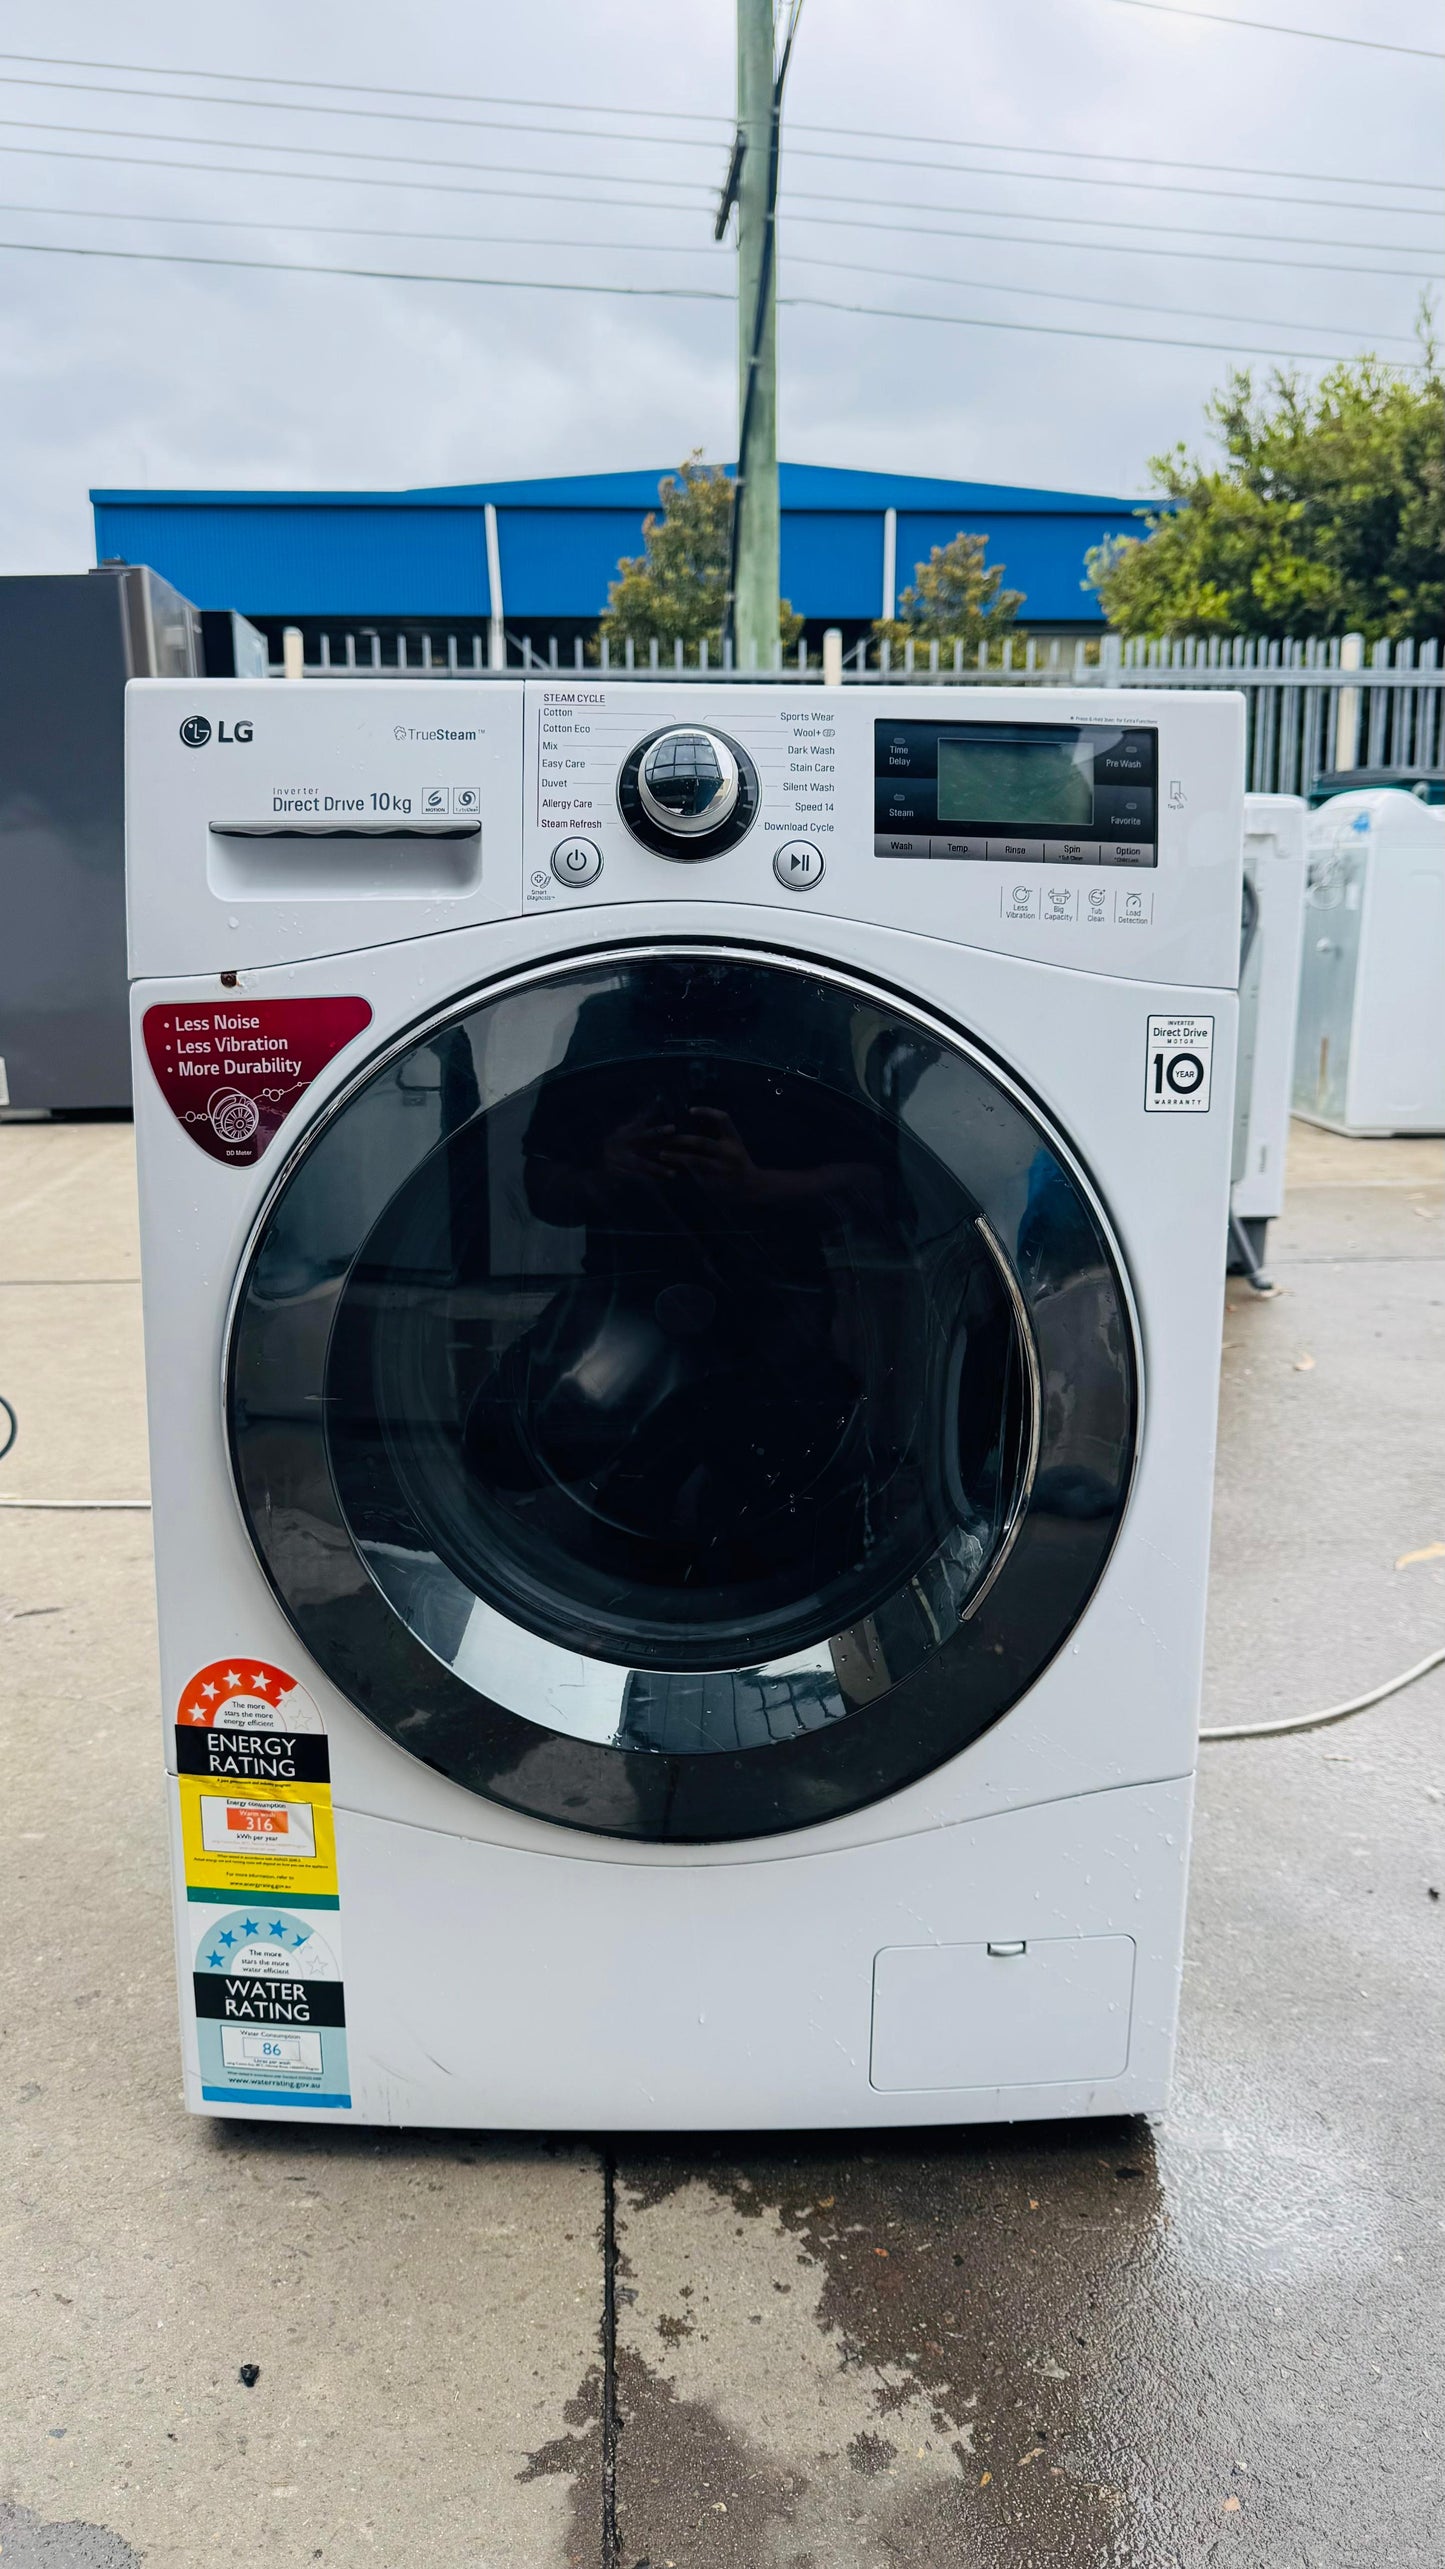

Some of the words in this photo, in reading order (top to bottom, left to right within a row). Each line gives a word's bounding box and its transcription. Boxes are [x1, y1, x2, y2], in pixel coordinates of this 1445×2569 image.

[543, 693, 575, 703] STEAM
[577, 694, 606, 703] CYCLE
[543, 707, 573, 717] Cotton
[780, 712, 810, 722] Sports
[811, 712, 835, 721] Wear
[218, 720, 254, 743] LG
[542, 723, 573, 733] Cotton
[574, 724, 591, 733] Eco
[793, 728, 822, 737] Wool+
[542, 741, 558, 750] Mix
[787, 745, 808, 755] Dark
[810, 746, 835, 755] Wash
[890, 745, 908, 755] Time
[542, 759, 563, 769] Easy
[565, 759, 586, 768] Care
[889, 756, 911, 767] Delay
[1106, 758, 1119, 768] Pre
[1120, 760, 1142, 769] Wash
[790, 762, 813, 772] Stain
[814, 763, 835, 772] Care
[541, 778, 568, 788] Duvet
[782, 782, 808, 791] Silent
[810, 783, 835, 792] Wash
[272, 787, 320, 795] Inverter
[273, 796, 320, 812] Direct
[324, 796, 365, 812] Drive
[370, 792, 390, 811] 10
[393, 795, 412, 814] kg
[542, 798, 572, 809] Allergy
[573, 799, 593, 808] Care
[795, 802, 823, 811] Speed
[825, 802, 834, 811] 14
[889, 808, 914, 817] Steam
[541, 819, 568, 828] Steam
[569, 819, 602, 829] Refresh
[1110, 815, 1142, 826] Favorite
[764, 821, 808, 832] Download
[810, 822, 835, 833] Cycle
[890, 841, 913, 850] Wash
[947, 843, 969, 853] Temp
[1005, 845, 1026, 855] Rinse
[1063, 844, 1081, 854] Spin
[1116, 846, 1141, 856] Option
[1053, 905, 1064, 914] Big
[1091, 907, 1103, 915] Tub
[1126, 909, 1141, 917] Load
[1005, 911, 1036, 919] Vibration
[1044, 912, 1073, 922] Capacity
[1087, 914, 1105, 922] Clean
[1118, 916, 1148, 925] Detection
[175, 1016, 210, 1032] Less
[214, 1014, 260, 1030] Noise
[1153, 1027, 1181, 1037] Direct
[1183, 1027, 1208, 1037] Drive
[177, 1038, 211, 1054] Less
[215, 1036, 288, 1053] Vibration
[178, 1060, 220, 1077] More
[224, 1057, 302, 1077] Durability
[1153, 1052, 1205, 1095] 10
[1175, 1070, 1195, 1078] YEAR
[232, 1701, 246, 1709] The
[223, 1718, 246, 1727] energy
[247, 1719, 274, 1728] efficient
[207, 1733, 297, 1756] ENERGY
[209, 1754, 296, 1777] RATING
[226, 1799, 247, 1808] Energy
[248, 1801, 287, 1809] consumption
[239, 1809, 259, 1817] Warm
[246, 1817, 273, 1832] 316
[225, 1978, 308, 2001] WATER
[225, 1999, 310, 2021] RATING
[261, 2031, 301, 2040] Consumption
[262, 2042, 282, 2056] 86
[228, 2077, 321, 2090] www.waterrating.gov.au
